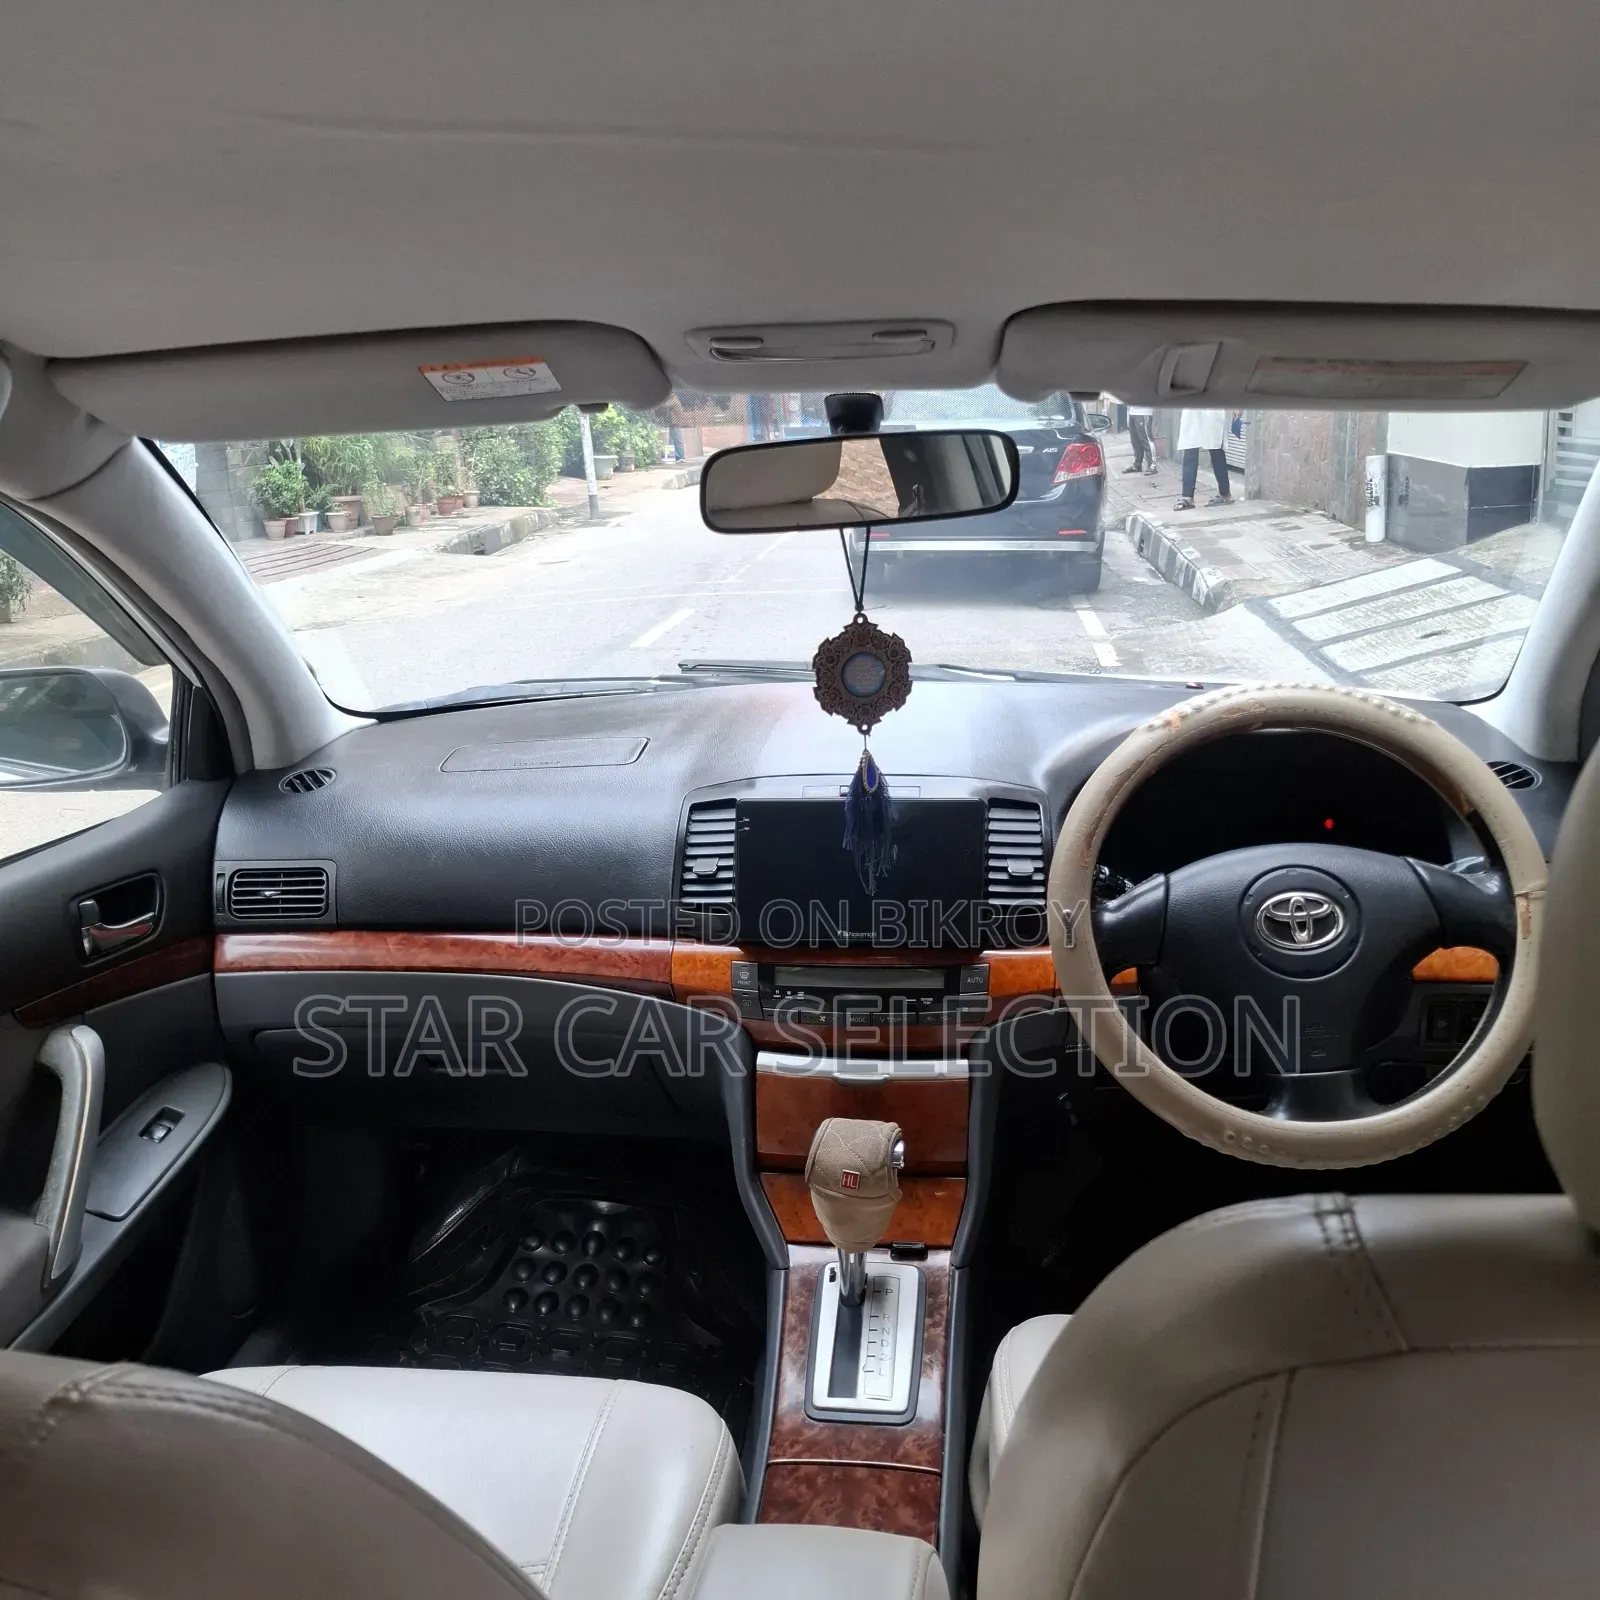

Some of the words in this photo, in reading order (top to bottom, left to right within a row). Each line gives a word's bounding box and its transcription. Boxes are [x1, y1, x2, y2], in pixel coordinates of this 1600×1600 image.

[885, 1288, 893, 1296] P
[883, 1313, 891, 1321] R
[882, 1327, 890, 1335] N
[881, 1339, 889, 1347] D
